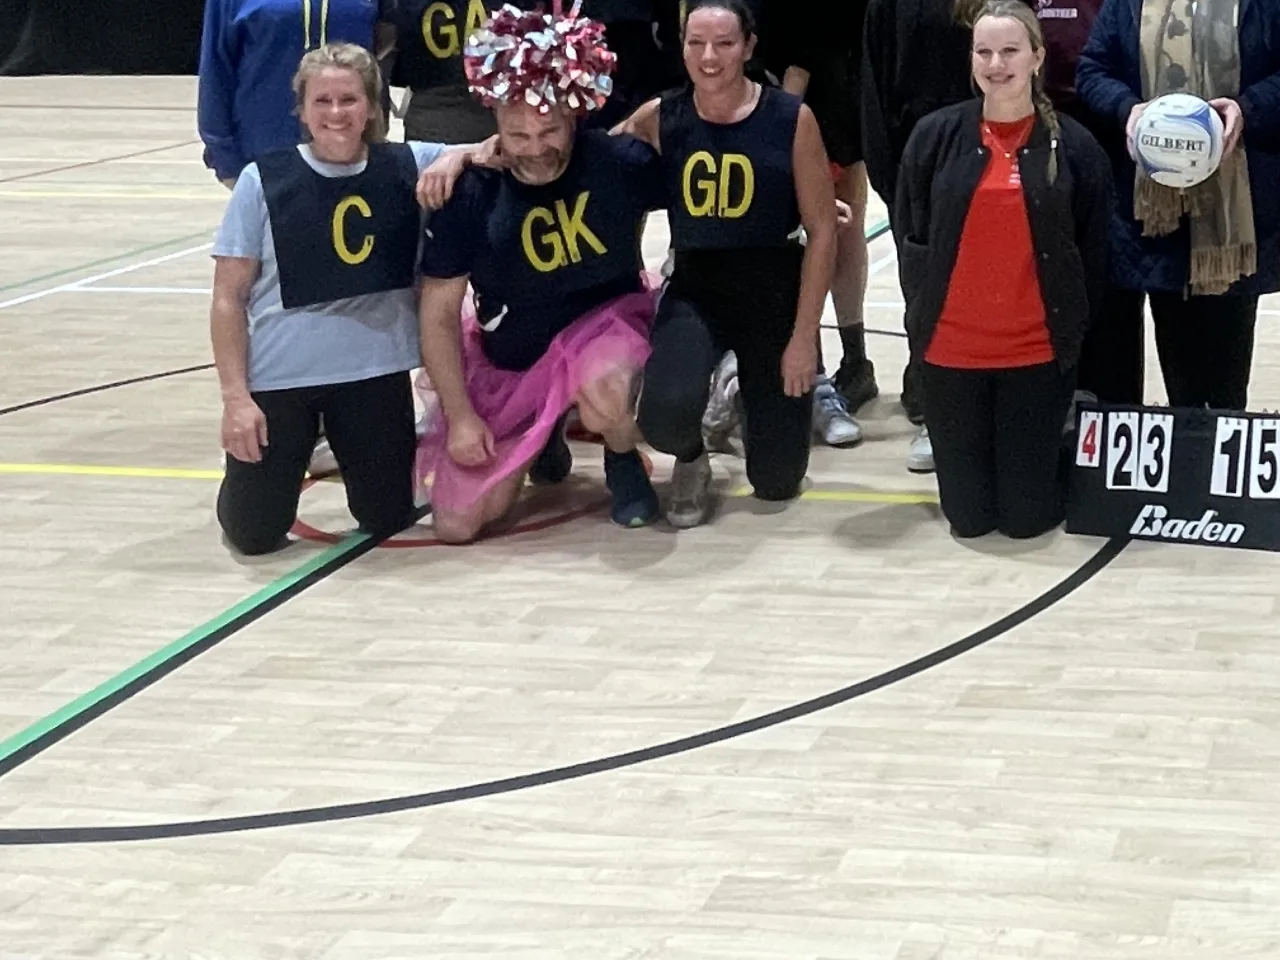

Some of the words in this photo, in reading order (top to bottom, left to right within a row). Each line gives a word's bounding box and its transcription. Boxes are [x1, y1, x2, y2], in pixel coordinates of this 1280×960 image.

[1140, 134, 1206, 152] GILBERT
[683, 150, 755, 217] GD
[332, 195, 374, 265] C
[521, 190, 608, 272] GK
[1081, 419, 1097, 463] 4
[1111, 422, 1165, 488] 23
[1218, 428, 1278, 493] 15
[1129, 504, 1245, 543] Baden
